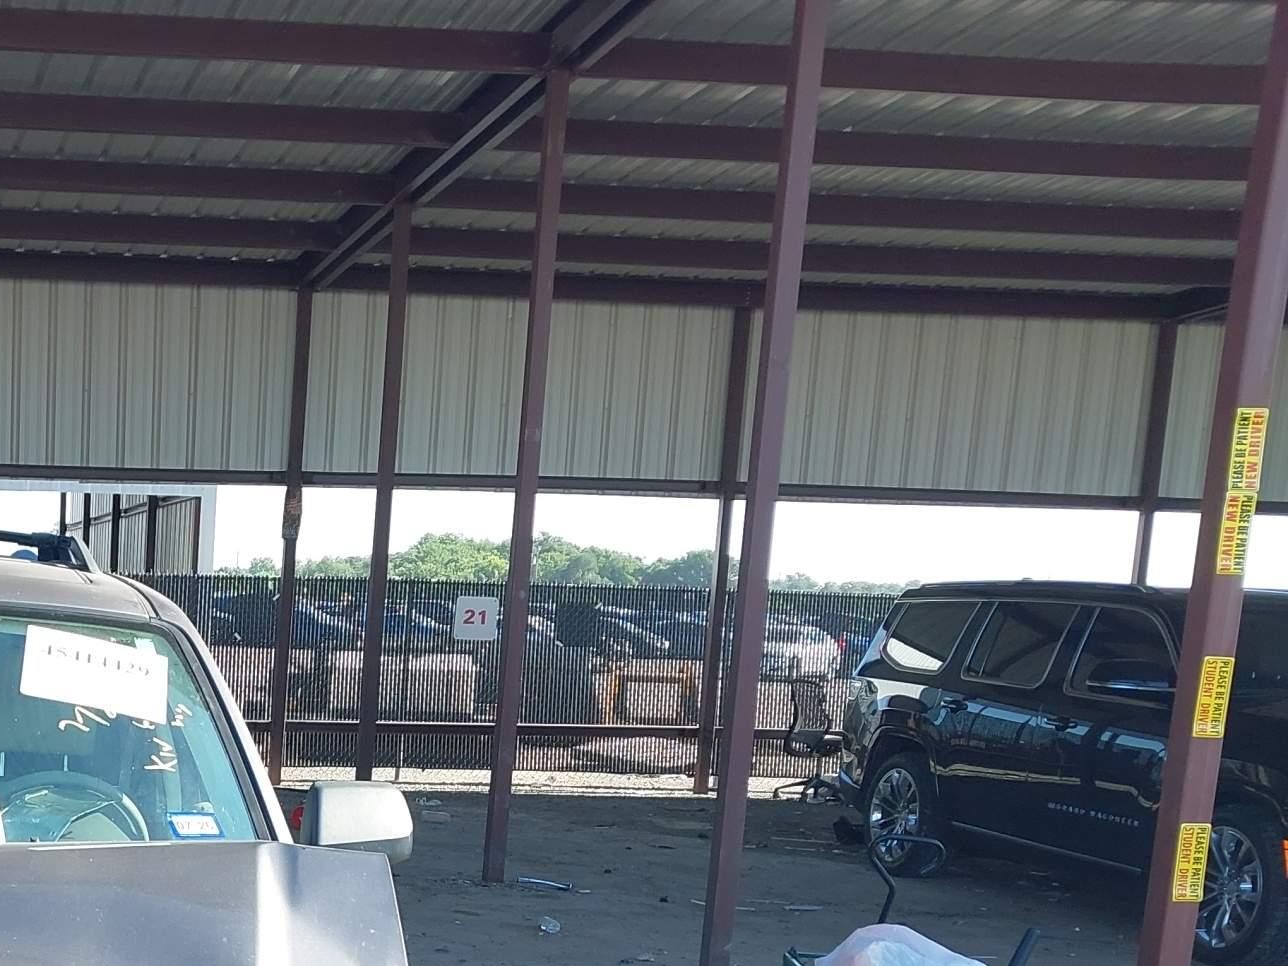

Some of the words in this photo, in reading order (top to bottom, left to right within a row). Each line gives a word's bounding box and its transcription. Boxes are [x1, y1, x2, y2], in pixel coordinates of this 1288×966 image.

[1236, 411, 1253, 446] PATIENT
[1247, 411, 1265, 457] DRIVER
[1234, 448, 1247, 458] BE
[1231, 460, 1246, 489] PLEASE
[1244, 461, 1258, 489] NEW
[1225, 494, 1241, 522] NEW
[1238, 494, 1254, 525] PLEASE
[1236, 526, 1249, 536] BE
[1219, 526, 1236, 572] DRIVER
[1233, 537, 1248, 571] PATIENT
[463, 609, 487, 625] 21
[1202, 660, 1218, 698] STUDENT
[1216, 661, 1230, 690] PLEASE
[1214, 691, 1225, 701] BE
[1196, 702, 1210, 734] DRIVER
[1209, 702, 1223, 734] PATIENT
[1181, 827, 1195, 865] STUDENT
[1193, 827, 1208, 855] PLEASE
[1192, 856, 1204, 866] BE
[1176, 868, 1190, 898] DRIVER
[1188, 867, 1202, 898] PATIENT
